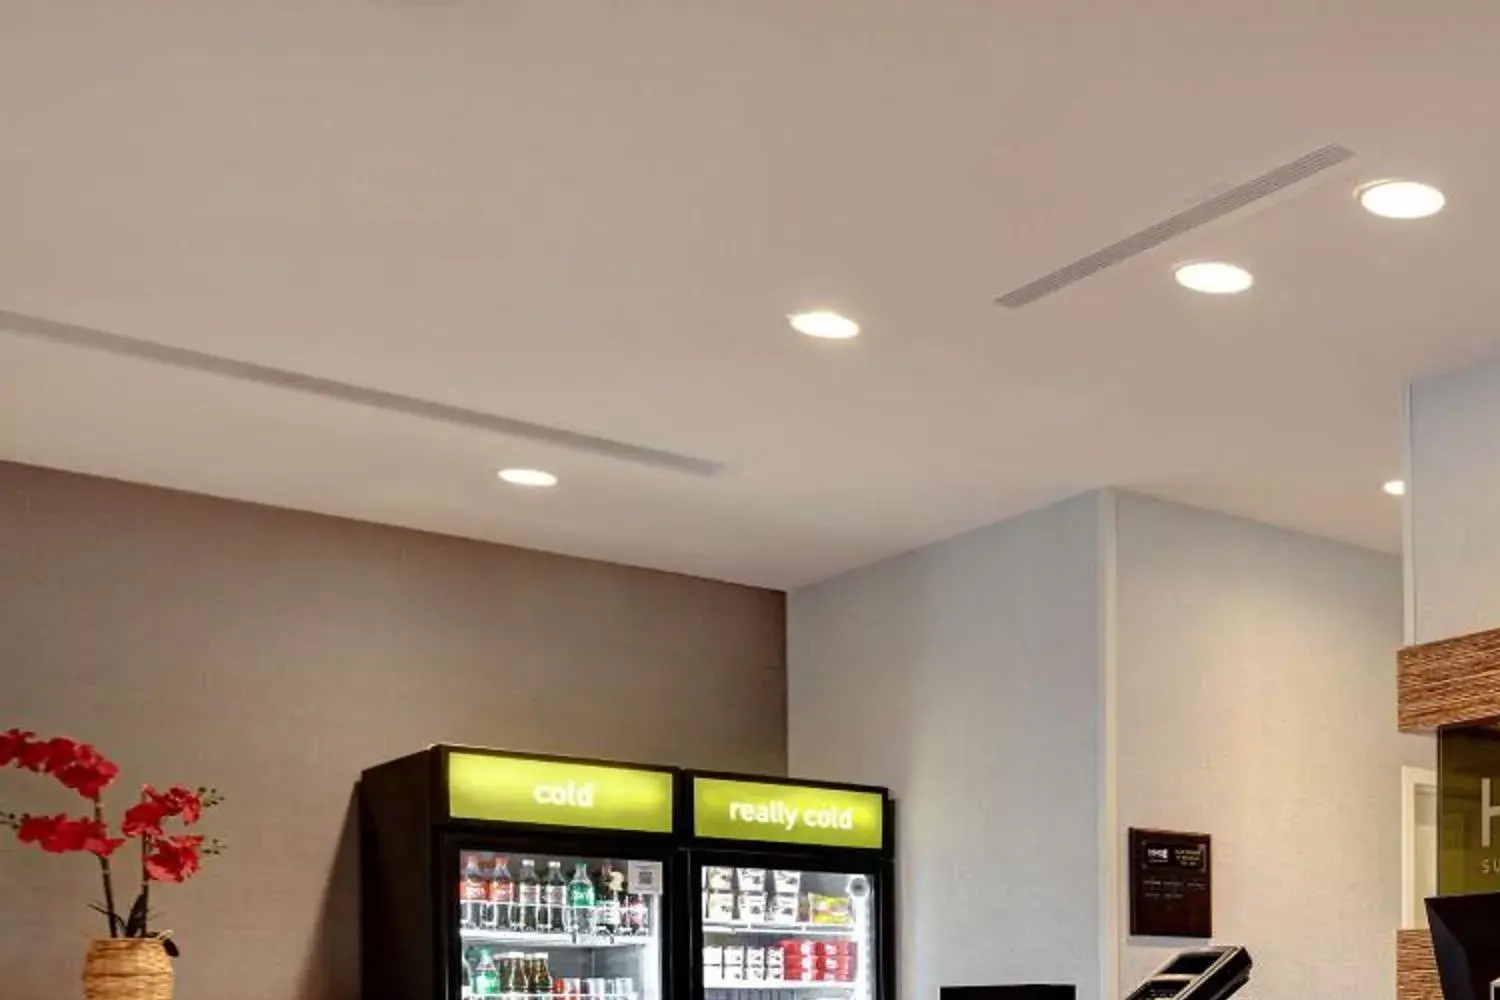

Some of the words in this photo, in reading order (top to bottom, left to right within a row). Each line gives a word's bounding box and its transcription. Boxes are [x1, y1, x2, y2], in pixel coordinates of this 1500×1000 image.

[533, 779, 595, 808] cold
[729, 800, 798, 831] really
[803, 803, 854, 830] cold
